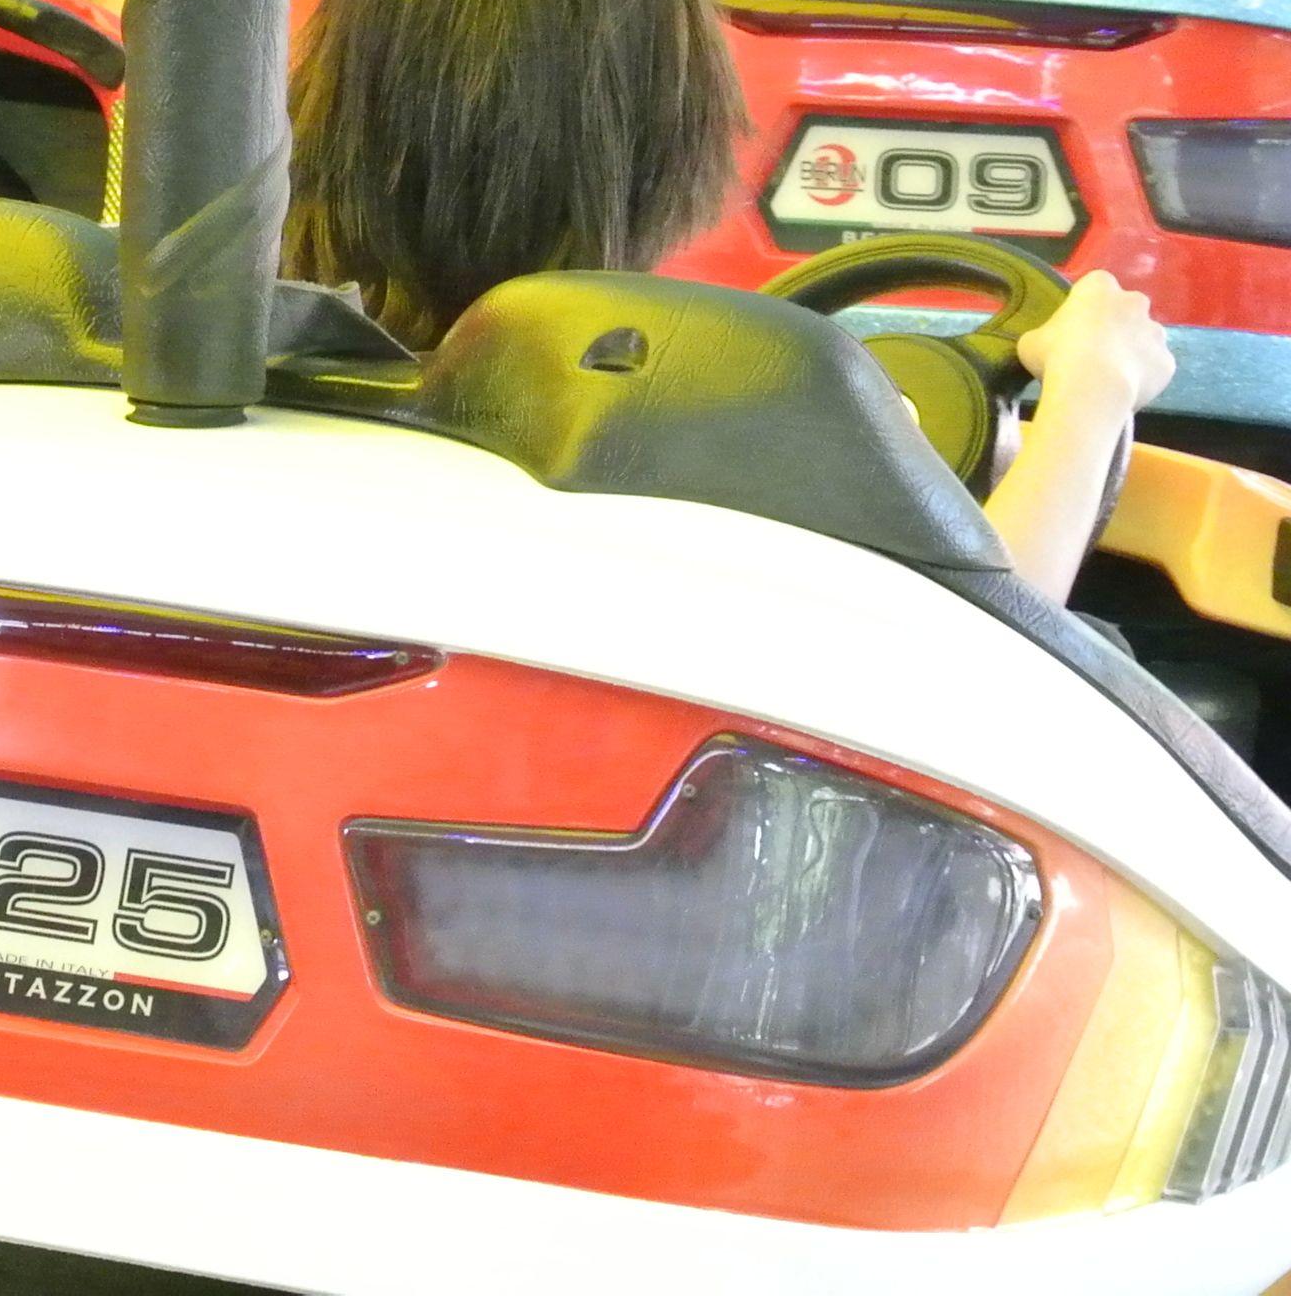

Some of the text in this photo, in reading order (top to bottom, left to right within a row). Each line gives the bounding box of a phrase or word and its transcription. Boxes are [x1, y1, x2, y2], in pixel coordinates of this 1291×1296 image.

[801, 160, 866, 184] BERLIN
[874, 147, 1048, 216] 09
[35, 958, 54, 969] IN
[62, 962, 110, 978] ITALY
